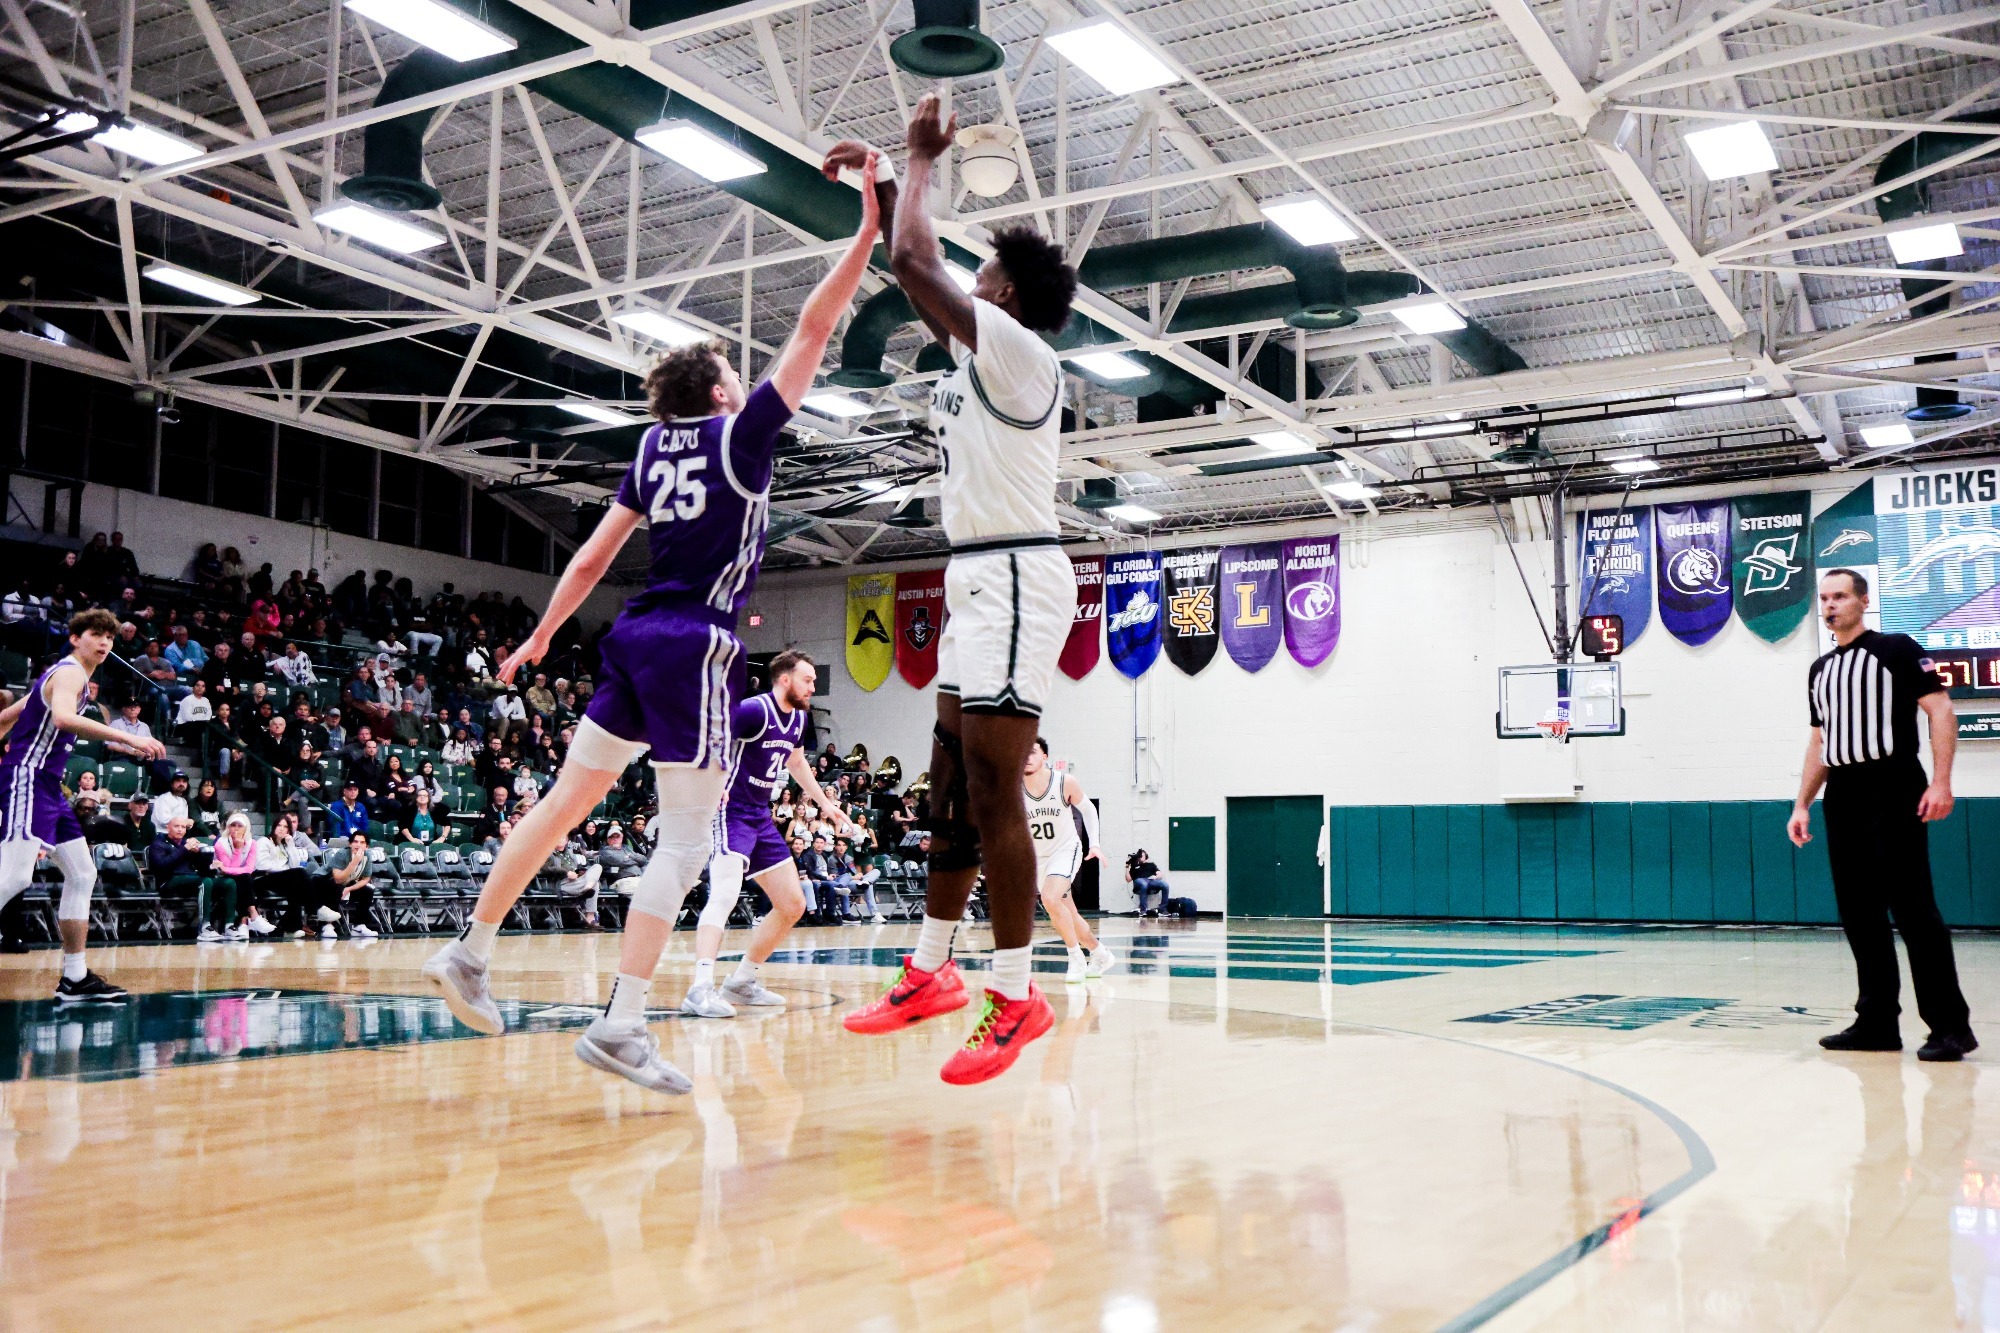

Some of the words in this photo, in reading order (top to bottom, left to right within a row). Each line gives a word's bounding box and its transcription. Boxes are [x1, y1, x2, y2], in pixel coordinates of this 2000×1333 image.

[647, 456, 707, 524] 25
[1891, 469, 1996, 509] JACKS
[1666, 521, 1720, 538] QUEENS
[1740, 514, 1803, 531] STETSON
[1294, 544, 1331, 557] NORTH
[1073, 562, 1099, 573] TERN
[1113, 558, 1154, 572] FLORIDA
[1163, 552, 1219, 568] KENNESAW
[1224, 559, 1279, 574] LIPSCOMB
[1286, 555, 1337, 571] ALABAMA
[1106, 574, 1129, 585] GULF
[1129, 570, 1161, 583] COAST
[1175, 566, 1206, 579] STATE
[897, 589, 924, 600] AUSTIN
[925, 586, 944, 598] PEAY
[1233, 581, 1271, 628] L
[1108, 602, 1159, 632] FGCU
[1935, 661, 1971, 687] 57
[1958, 724, 1988, 732] AND
[1031, 822, 1055, 840] 20
[103, 843, 125, 858] JU
